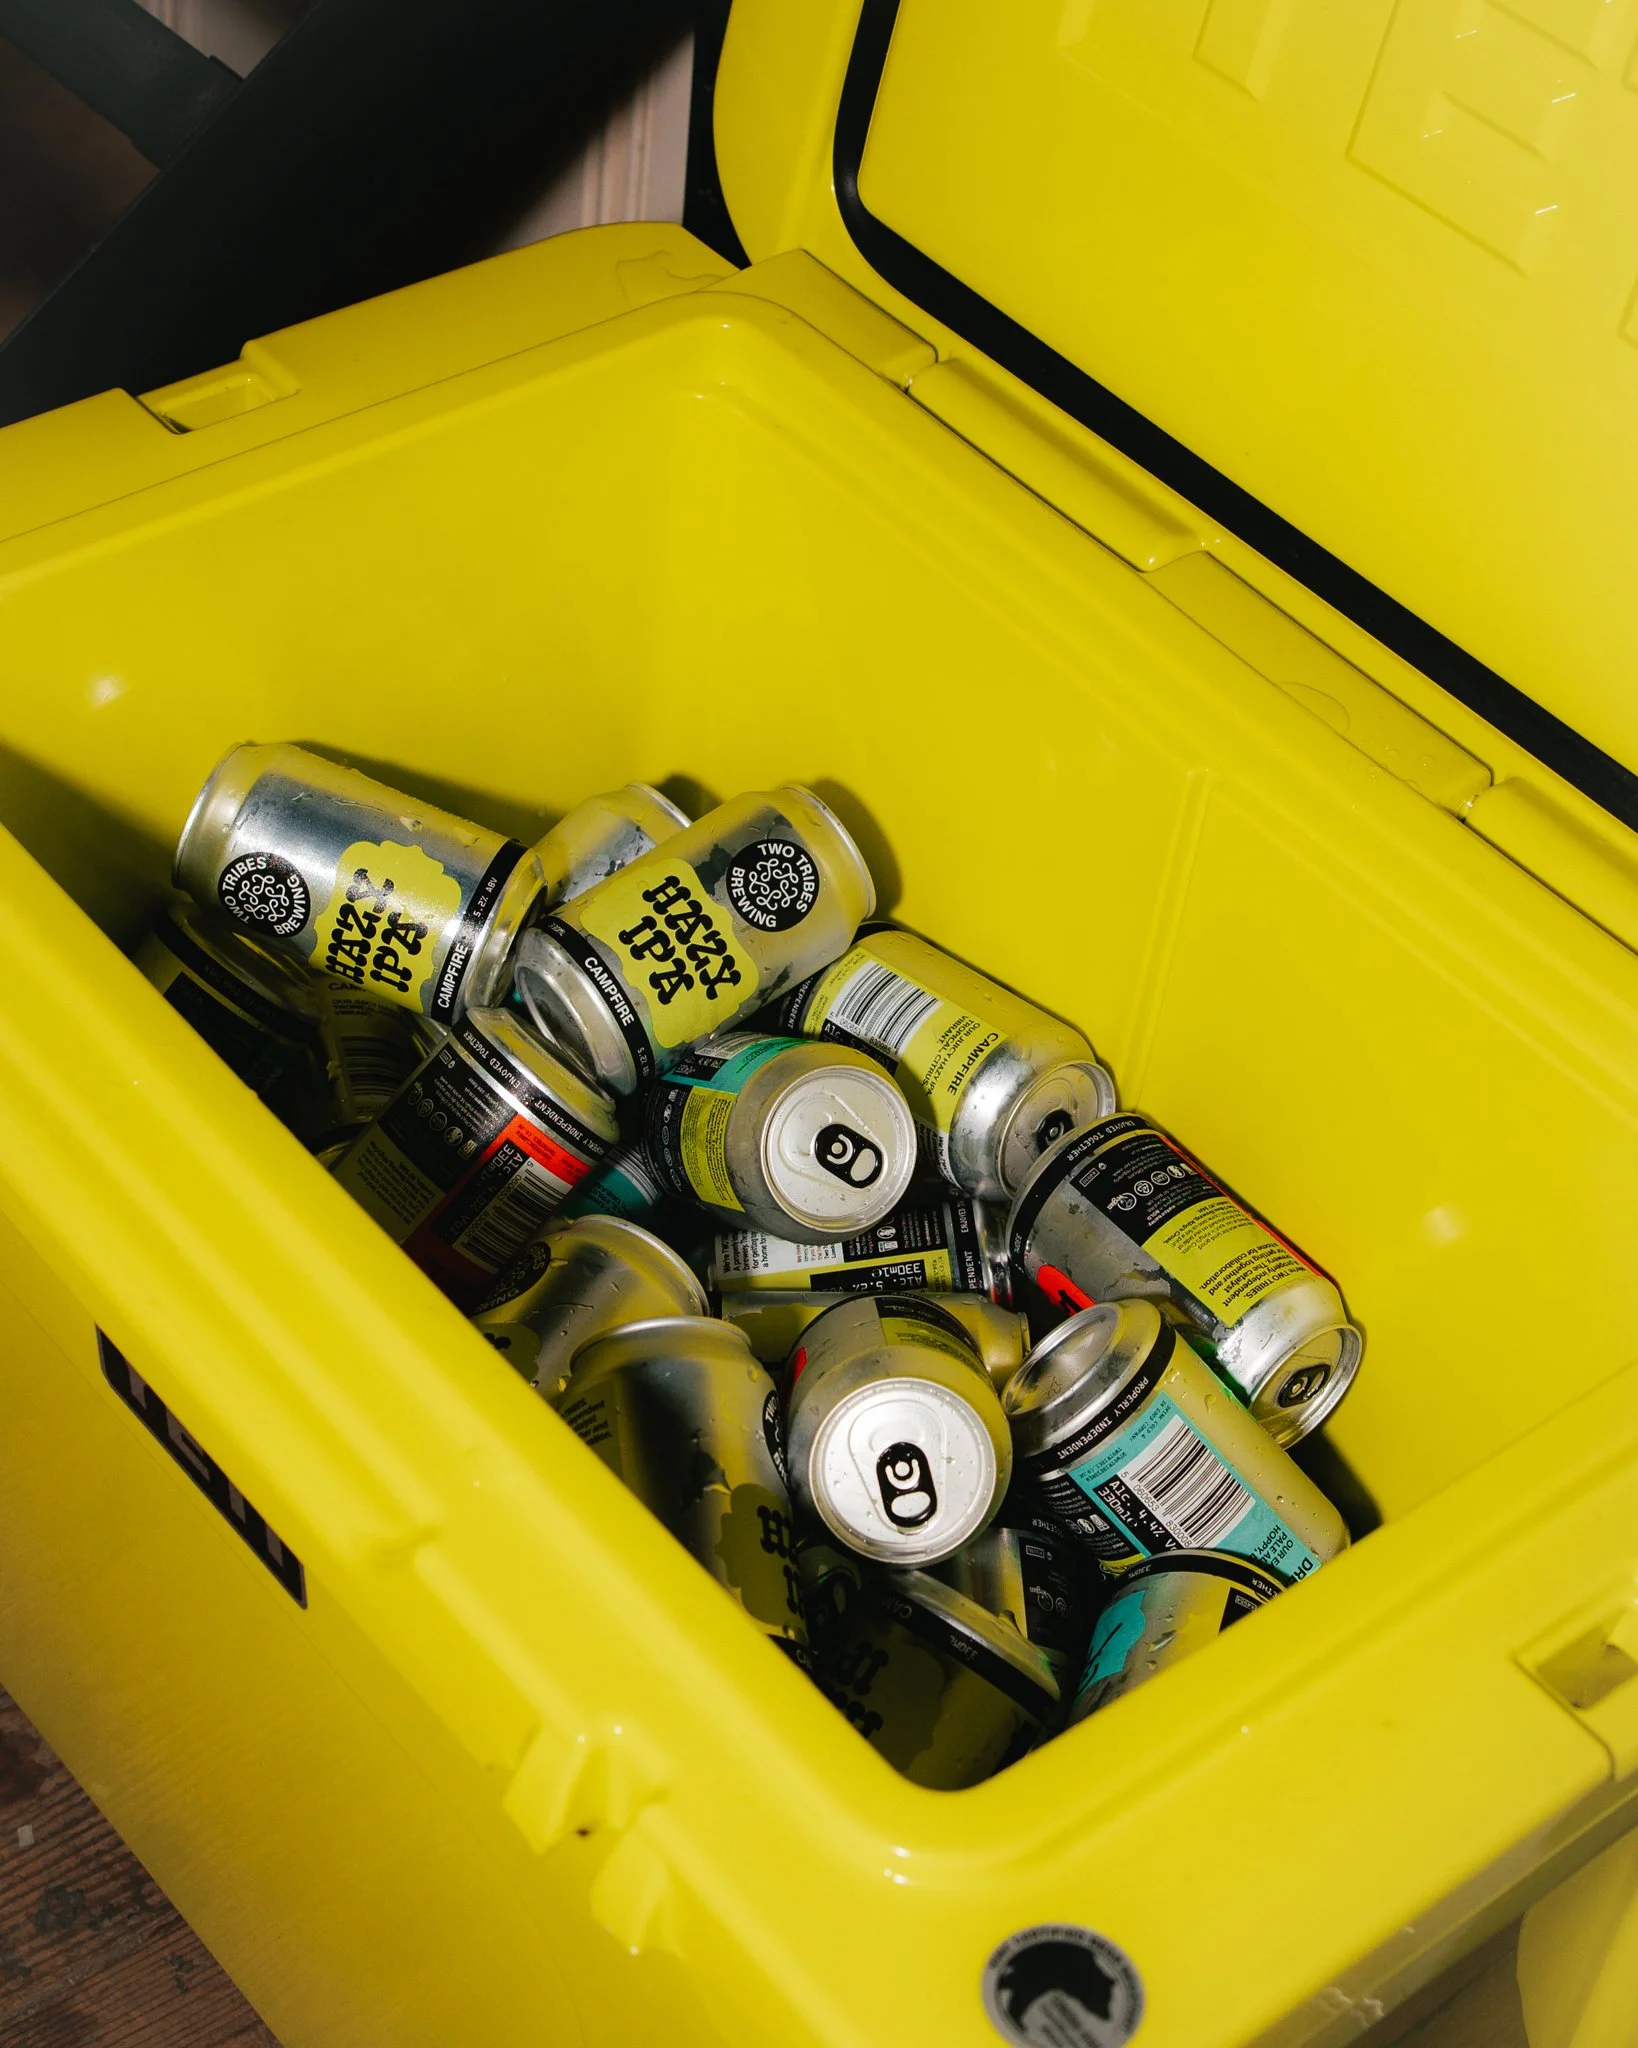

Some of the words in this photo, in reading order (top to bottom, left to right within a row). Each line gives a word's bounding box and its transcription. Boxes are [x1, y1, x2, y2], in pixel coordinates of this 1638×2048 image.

[757, 842, 796, 859] TWO
[222, 855, 267, 891] TRIBES
[794, 854, 817, 913] TRIBES
[223, 896, 251, 925] TWO
[274, 874, 306, 936] BREWING
[730, 865, 777, 928] BREWING
[325, 868, 395, 985] HAZY
[642, 874, 742, 1001] HAZY
[370, 911, 428, 993] IPA
[437, 942, 469, 1009] CAMPFIRE
[473, 895, 489, 918] 5.2%
[618, 915, 695, 1006] IPA
[584, 956, 635, 1027] CAMPFIRE
[461, 1029, 490, 1059] TOGETHER
[868, 1035, 892, 1054] 830985
[935, 1014, 968, 1045] VIBRANT.
[937, 1017, 974, 1055] TROPICAL,
[960, 1021, 980, 1039] OUR
[945, 1035, 965, 1059] JUICY
[487, 1056, 521, 1089] ENJOYED
[919, 1053, 942, 1088] CITRUS,
[931, 1057, 949, 1082] HAZY
[947, 1031, 1000, 1096] CAMPFIRE
[533, 1098, 584, 1141] INDEPENDENT
[1106, 1119, 1136, 1134] ENJOYED
[1066, 1130, 1104, 1162] TOGETHER
[722, 1253, 731, 1273] We're
[751, 1238, 759, 1258] getting
[751, 1258, 759, 1268] for
[760, 1244, 768, 1262] home
[892, 1274, 922, 1288] Alc.
[964, 1251, 977, 1289] PENDENT
[1197, 1251, 1248, 1292] collaboration.
[1222, 1256, 1254, 1284] together
[1222, 1268, 1254, 1294] catalyst
[1251, 1260, 1267, 1274] The
[1270, 1269, 1289, 1282] TWO
[1207, 1279, 1225, 1296] and
[1221, 1269, 1268, 1308] independent
[1242, 1276, 1273, 1301] TRIBES.
[1114, 1377, 1150, 1417] PROPERLY
[1057, 1416, 1113, 1461] INDEPENDENT
[1108, 1478, 1134, 1507] Alc.
[1136, 1509, 1166, 1538] 4.4%
[1119, 1469, 1129, 1479] 5
[1133, 1482, 1160, 1512] 060653
[1164, 1518, 1193, 1548] 830008
[1254, 1524, 1281, 1554] HOPPY,
[1269, 1532, 1288, 1554] PALE
[1278, 1540, 1293, 1559] OUR
